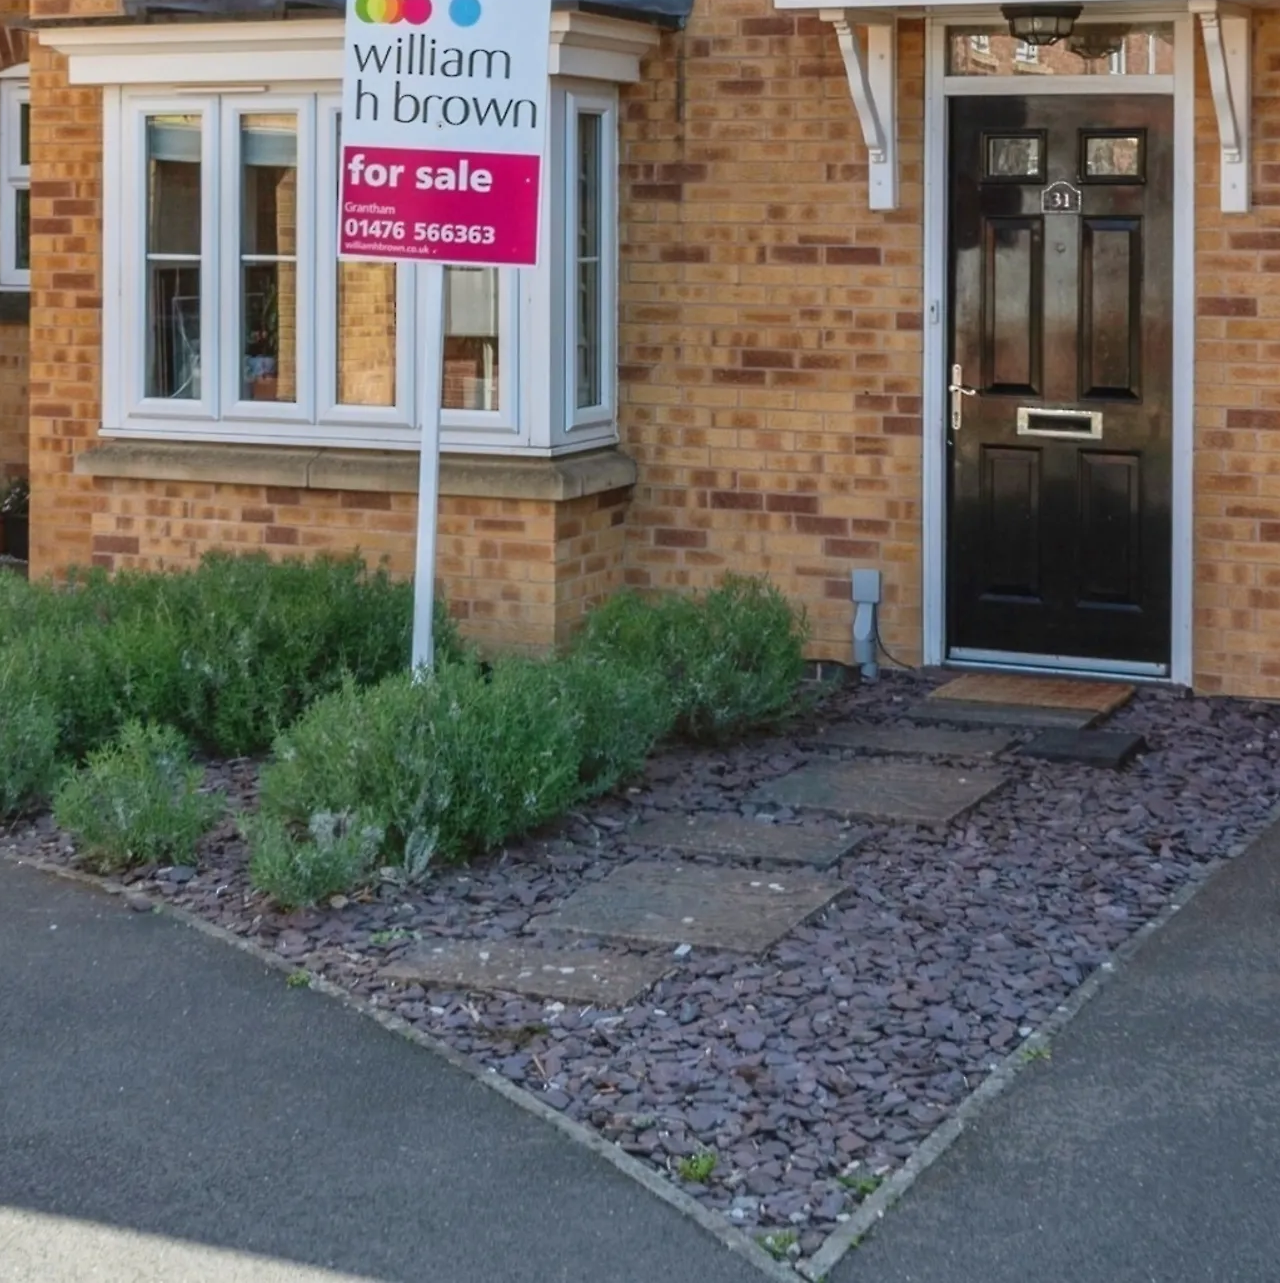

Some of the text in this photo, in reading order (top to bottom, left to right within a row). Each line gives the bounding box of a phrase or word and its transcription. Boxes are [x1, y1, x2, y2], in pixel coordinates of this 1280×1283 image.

[354, 33, 511, 79] william
[355, 79, 538, 129] h brown
[348, 154, 493, 193] for sale
[344, 201, 396, 215] Grantham
[1051, 192, 1070, 208] 31
[345, 218, 496, 245] 01476 566363
[345, 241, 430, 254] williamhbrown.co.uk
